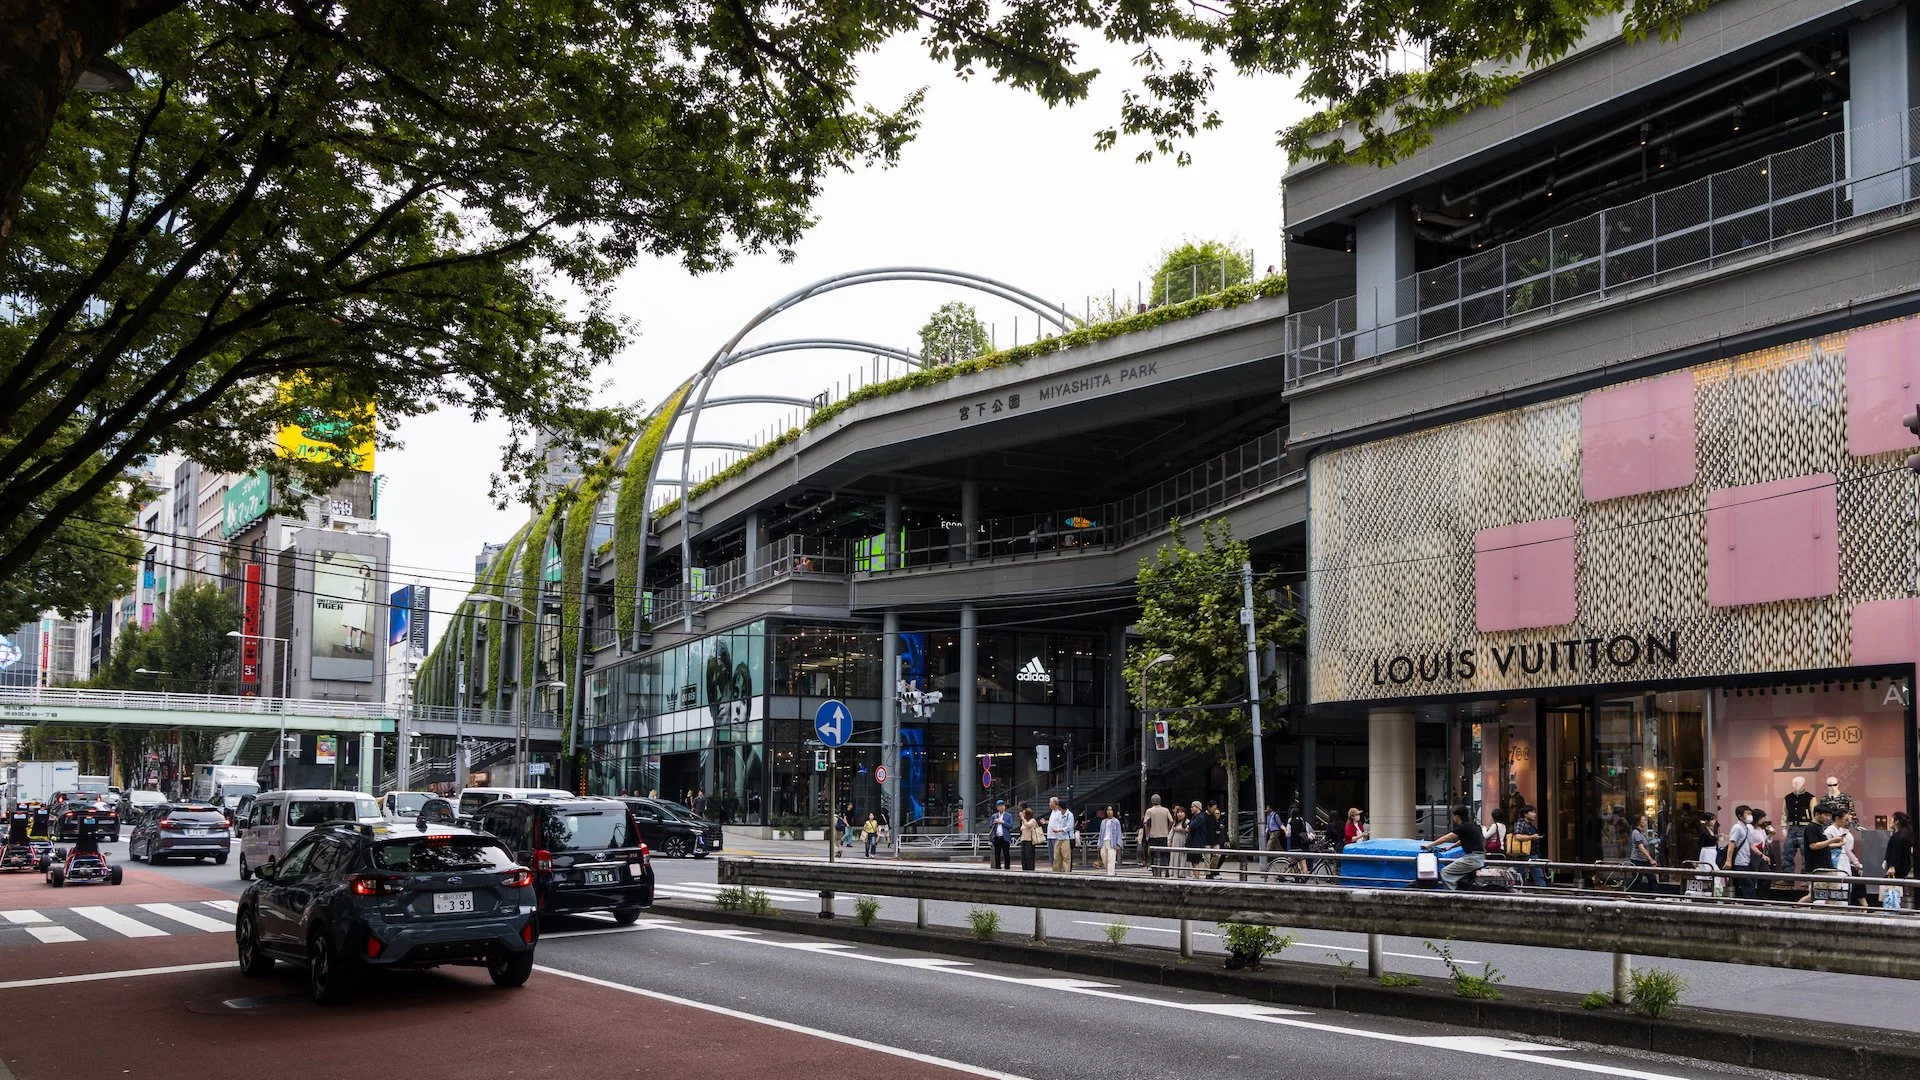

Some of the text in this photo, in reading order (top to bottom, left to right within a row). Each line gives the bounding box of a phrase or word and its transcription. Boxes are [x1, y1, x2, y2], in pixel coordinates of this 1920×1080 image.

[1039, 362, 1158, 401] MIYASHITA PARK
[317, 602, 343, 610] TIGER
[1373, 631, 1677, 685] LOUIS VUITTON
[1016, 671, 1050, 682] adidas
